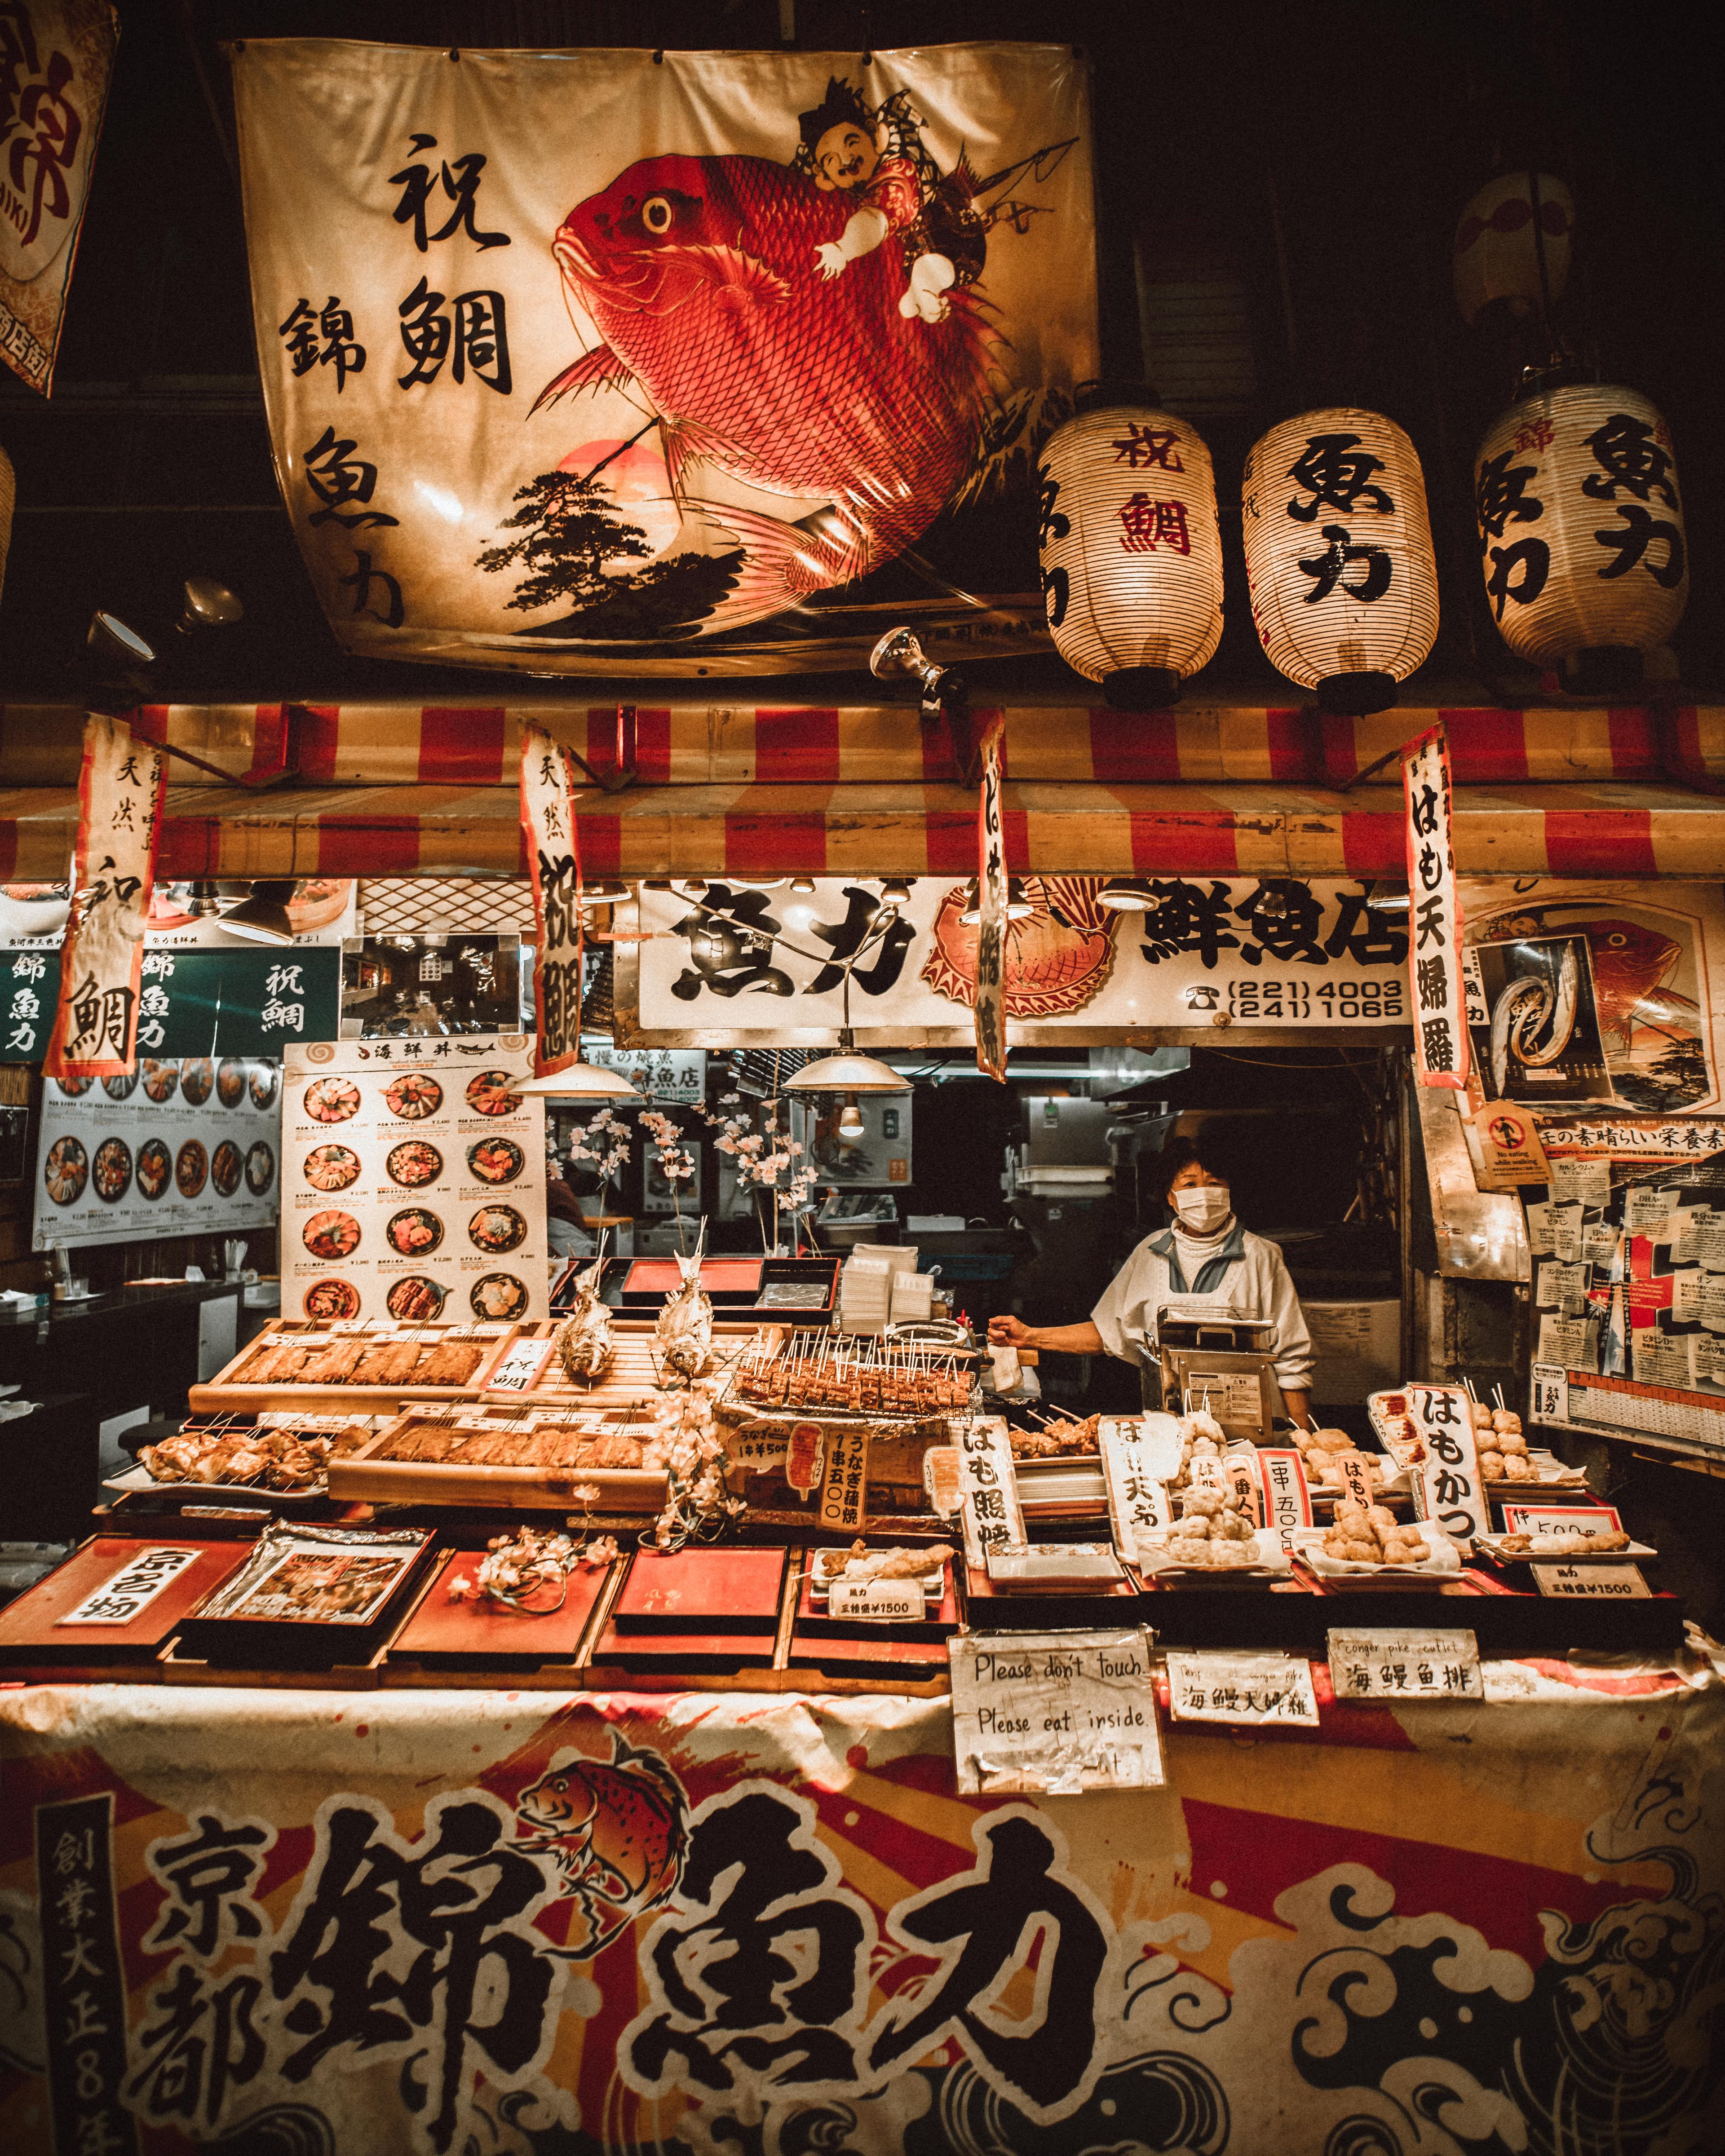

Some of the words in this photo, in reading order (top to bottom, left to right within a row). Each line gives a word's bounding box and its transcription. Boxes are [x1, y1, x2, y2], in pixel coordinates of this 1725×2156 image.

[388, 133, 512, 395] 祝鯛
[279, 296, 404, 629] 錦魚力
[1112, 422, 1191, 556] 祝鯛
[1579, 414, 1685, 588] 魚力
[1287, 433, 1396, 603] 魚力
[669, 883, 916, 1001] 魚力
[1139, 879, 1409, 970] 鮮魚店
[1411, 784, 1452, 1073] はも天婦羅
[5, 952, 46, 1052] 錦魚力
[136, 950, 175, 1049] 錦魚力
[261, 964, 305, 1033] 祝鯛
[1228, 980, 1402, 999] (221)4003
[1228, 999, 1403, 1019] (241)1065
[374, 1041, 452, 1060] 海鮮丼
[740, 1427, 770, 1441] うなぎ
[842, 1436, 864, 1525] うなぎ蒲焼
[1115, 1421, 1158, 1527] は天ぷ
[1422, 1390, 1476, 1539] はもかつ
[963, 1423, 1012, 1556] はも照焼
[80, 1550, 192, 1619] 京名物
[975, 1653, 1033, 1683] Please
[1043, 1653, 1082, 1679] don't
[1345, 1644, 1379, 1657] conger
[1388, 1641, 1410, 1657] pike
[1423, 1640, 1458, 1653] cutlet
[978, 1707, 1031, 1735] Please
[1043, 1710, 1071, 1732] eat
[128, 1815, 270, 2127] 京都
[270, 1794, 1108, 2154] 錦魚力
